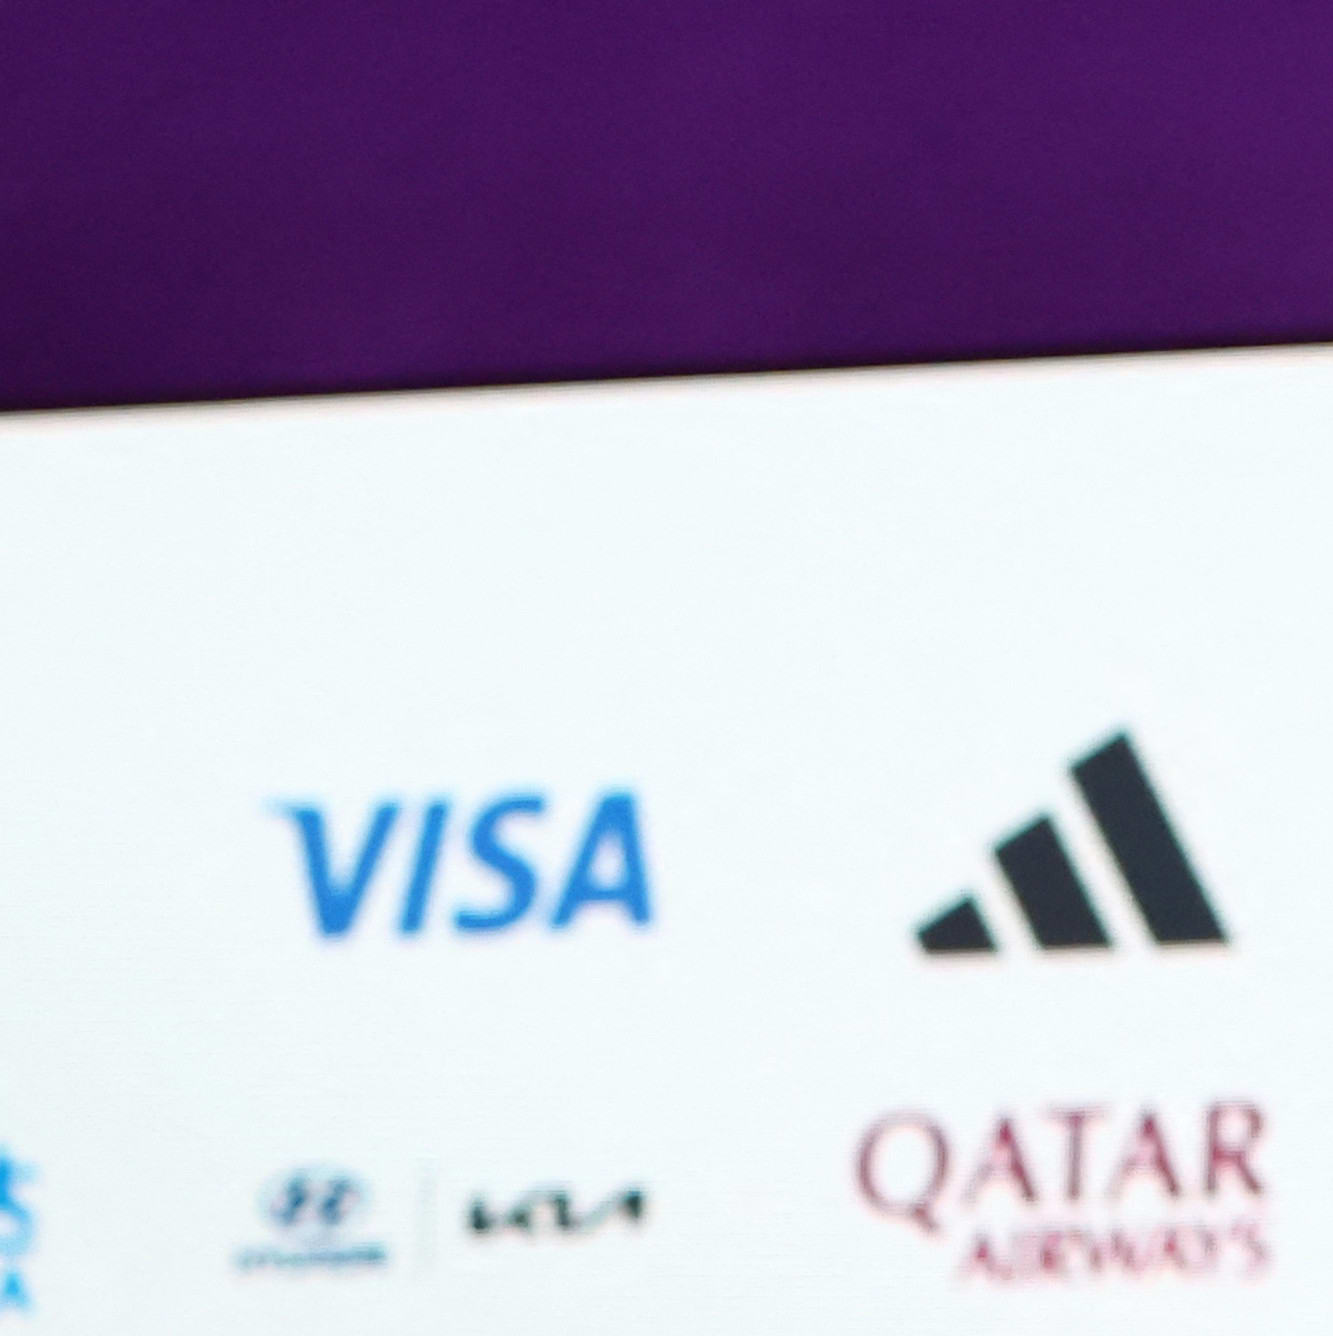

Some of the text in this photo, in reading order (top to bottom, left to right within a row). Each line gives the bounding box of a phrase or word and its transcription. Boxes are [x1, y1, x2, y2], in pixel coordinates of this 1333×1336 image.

[270, 789, 654, 940] VISA
[854, 1099, 1268, 1240] QATAR
[962, 1222, 1270, 1284] AIRWAYS
